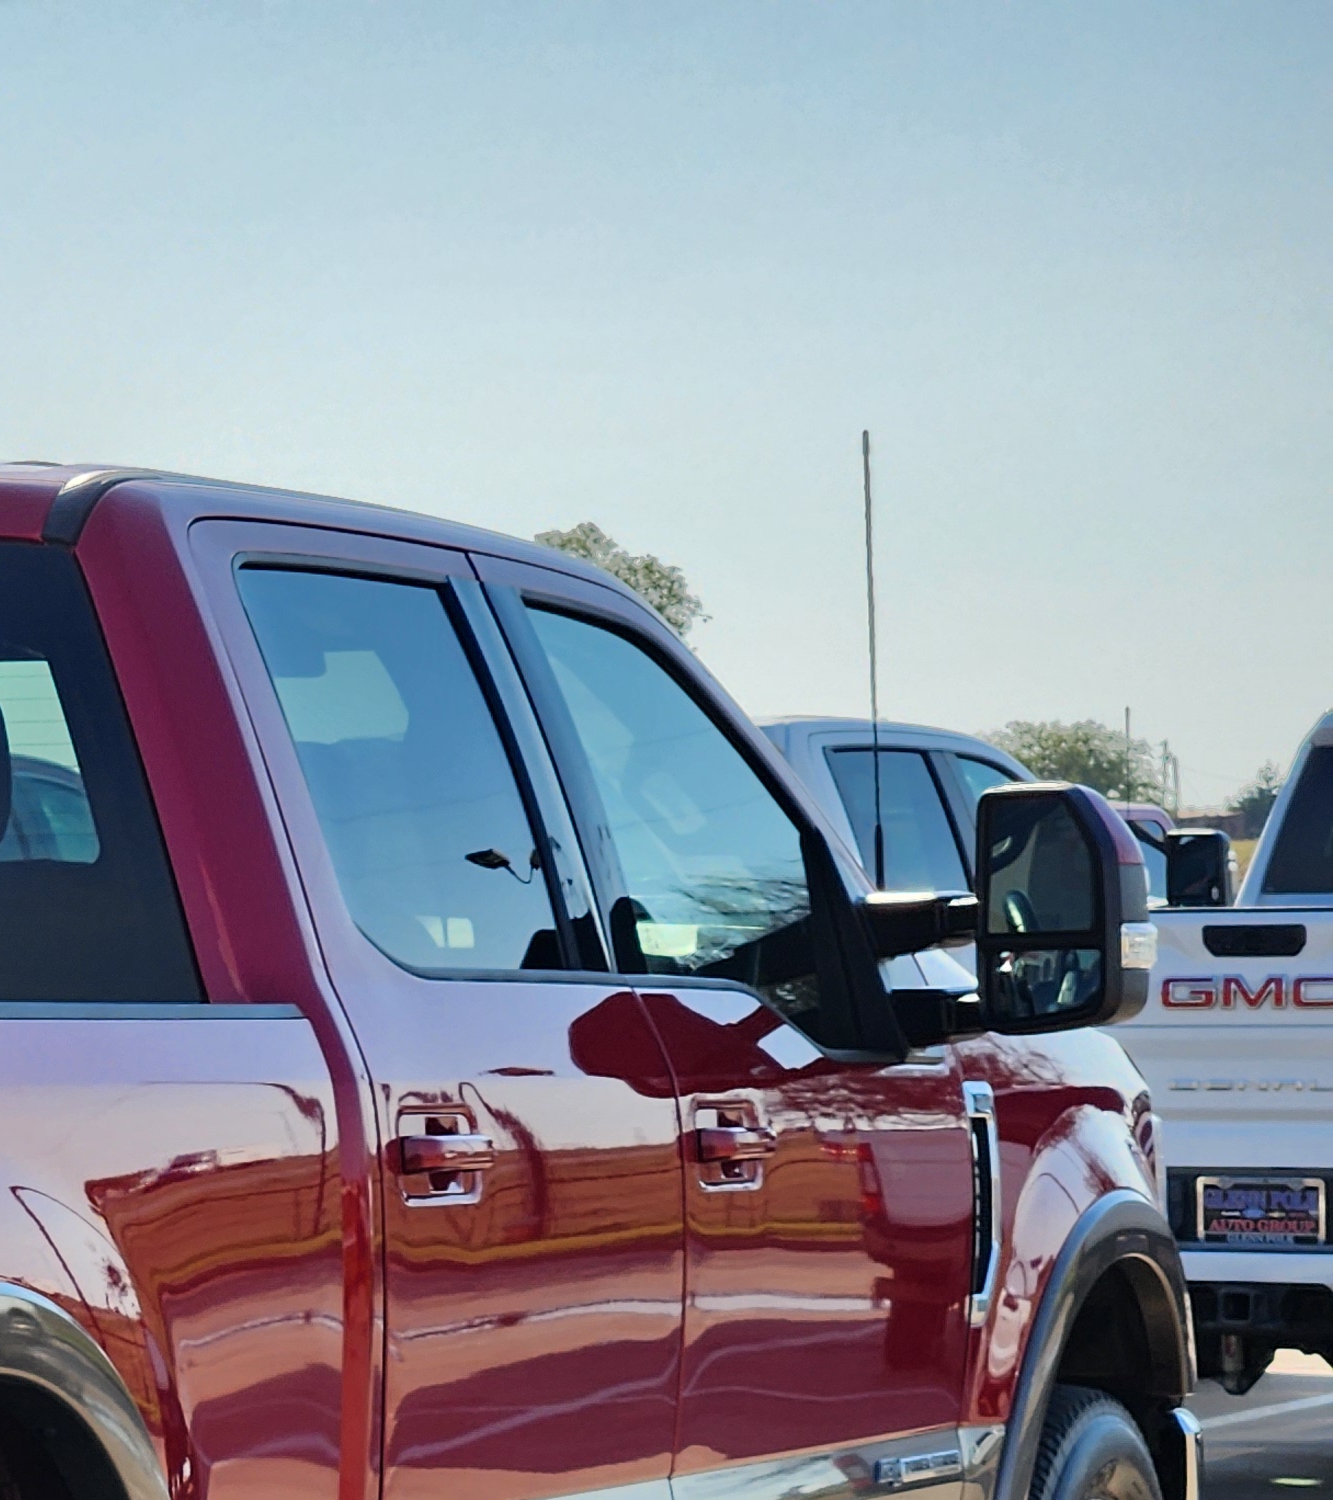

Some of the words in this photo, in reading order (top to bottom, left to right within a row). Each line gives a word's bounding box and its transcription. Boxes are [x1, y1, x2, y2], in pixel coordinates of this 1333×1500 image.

[1161, 975, 1333, 1009] GMC
[1208, 1219, 1253, 1232] AUTO
[1257, 1219, 1316, 1232] GROUP
